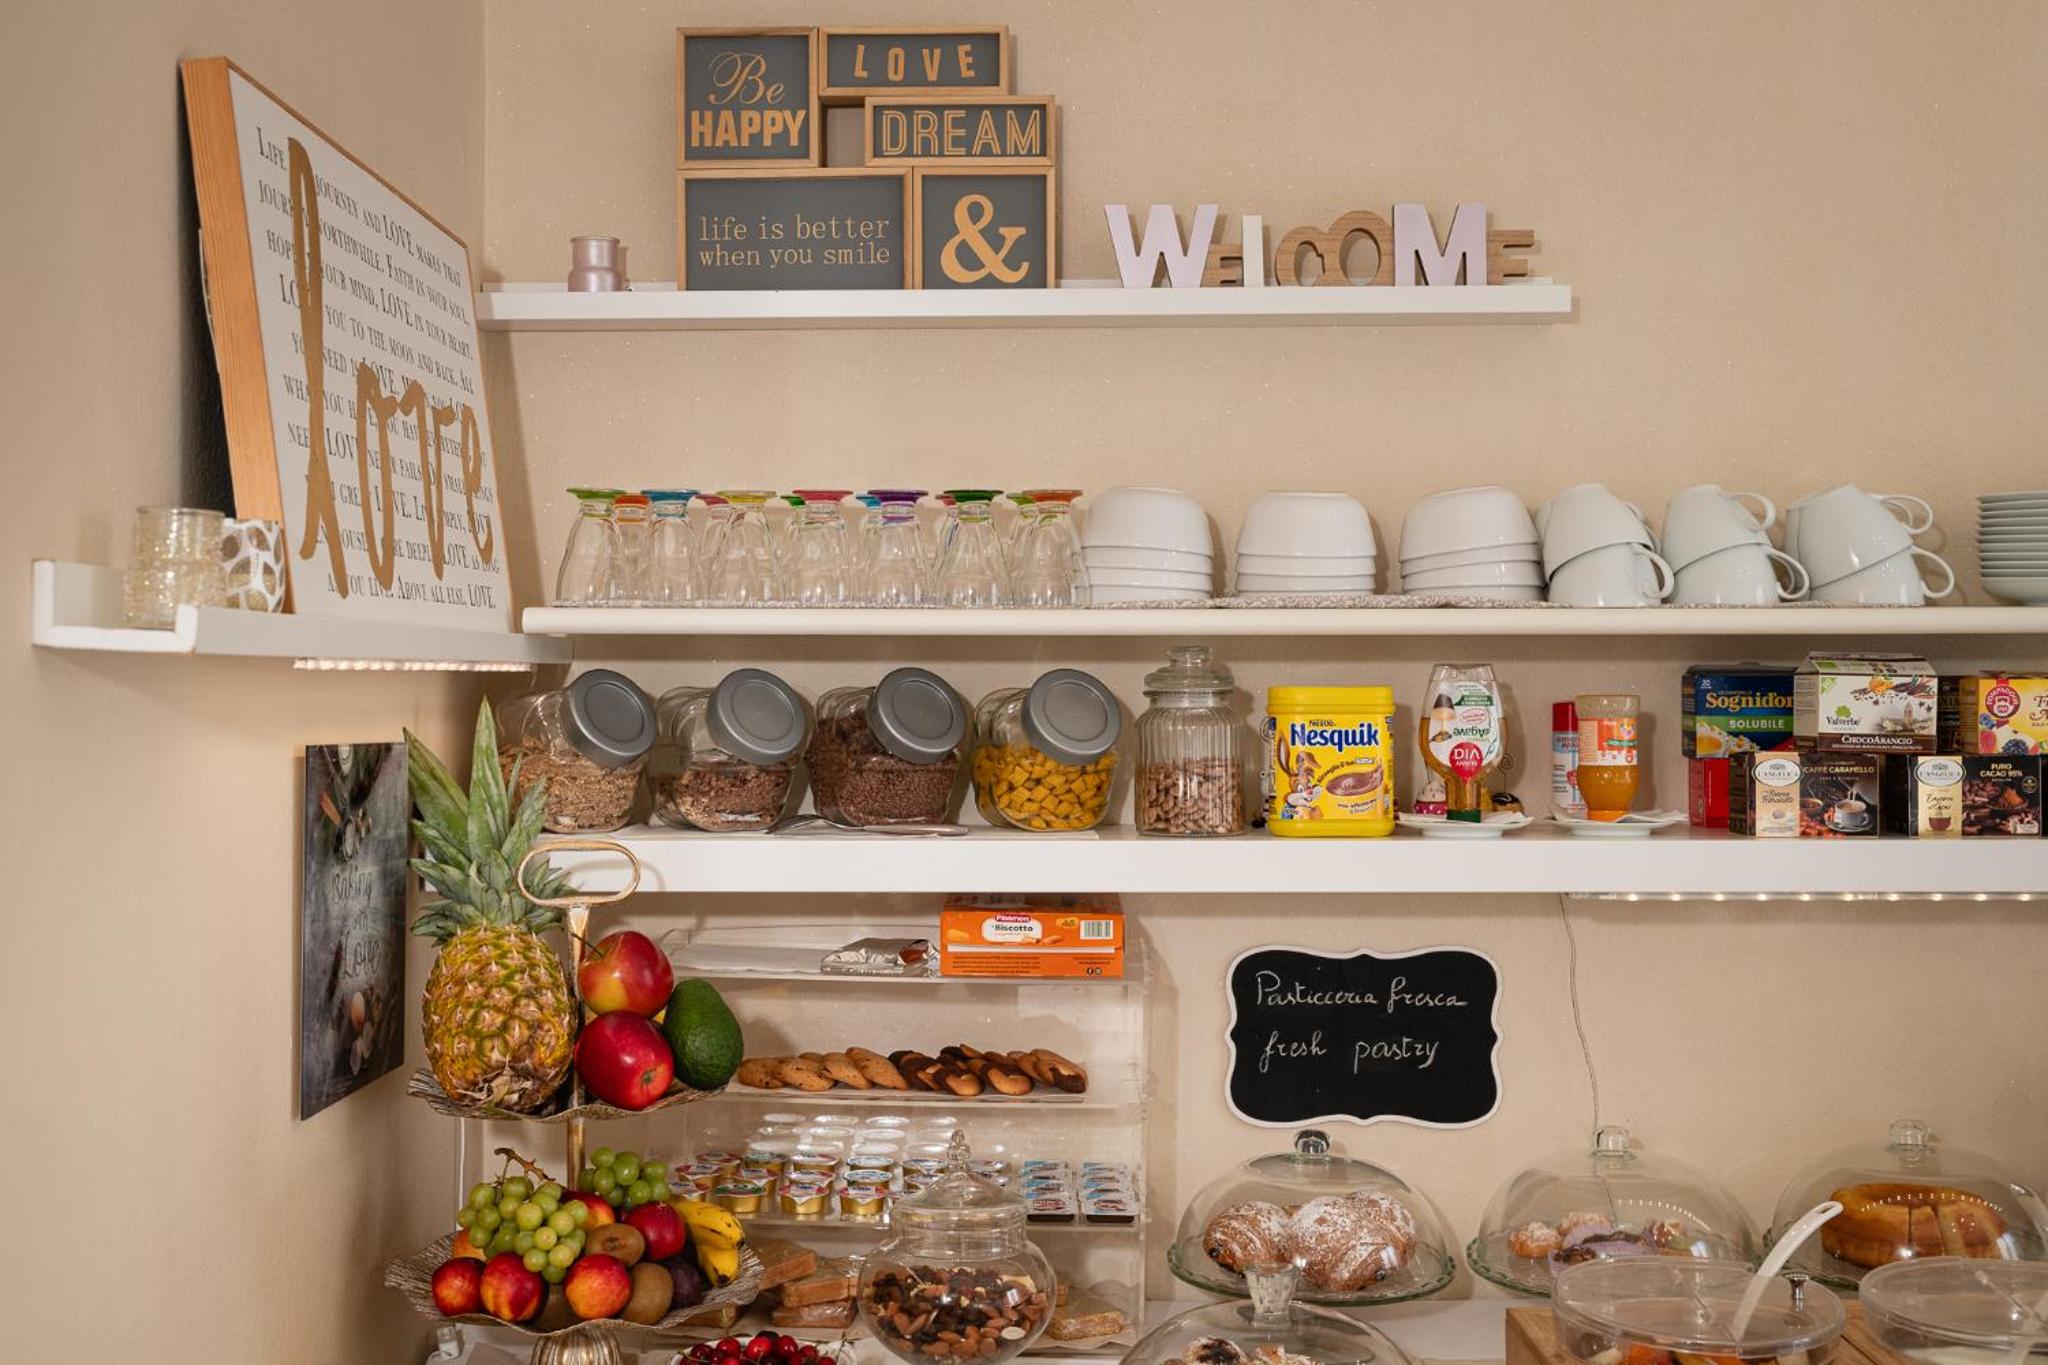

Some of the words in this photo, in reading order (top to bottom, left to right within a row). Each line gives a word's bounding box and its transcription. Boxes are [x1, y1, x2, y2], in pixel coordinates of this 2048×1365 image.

[708, 51, 786, 105] Be
[853, 43, 975, 81] LOVE
[690, 109, 806, 147] HAPPY
[881, 109, 1040, 155] DREAM
[382, 214, 414, 255] LOVE
[700, 216, 747, 241] life
[758, 216, 785, 240] is
[796, 215, 889, 240] better
[940, 194, 1030, 283] &
[700, 243, 761, 267] when
[769, 247, 813, 269] you
[823, 243, 890, 265] smile
[379, 287, 412, 325] LOVE
[325, 305, 347, 332] YOU
[349, 318, 364, 340] TO
[366, 326, 387, 351] THE
[467, 584, 495, 608] LOVE.
[1290, 722, 1379, 752] Nesquik
[1729, 720, 1785, 729] SOLUBILE
[1980, 770, 2007, 778] CACAO
[1255, 969, 1379, 1006] Pasticceria
[1387, 976, 1468, 1014] fresca
[1259, 1030, 1327, 1074] fresh
[1353, 1037, 1440, 1075] pastry
